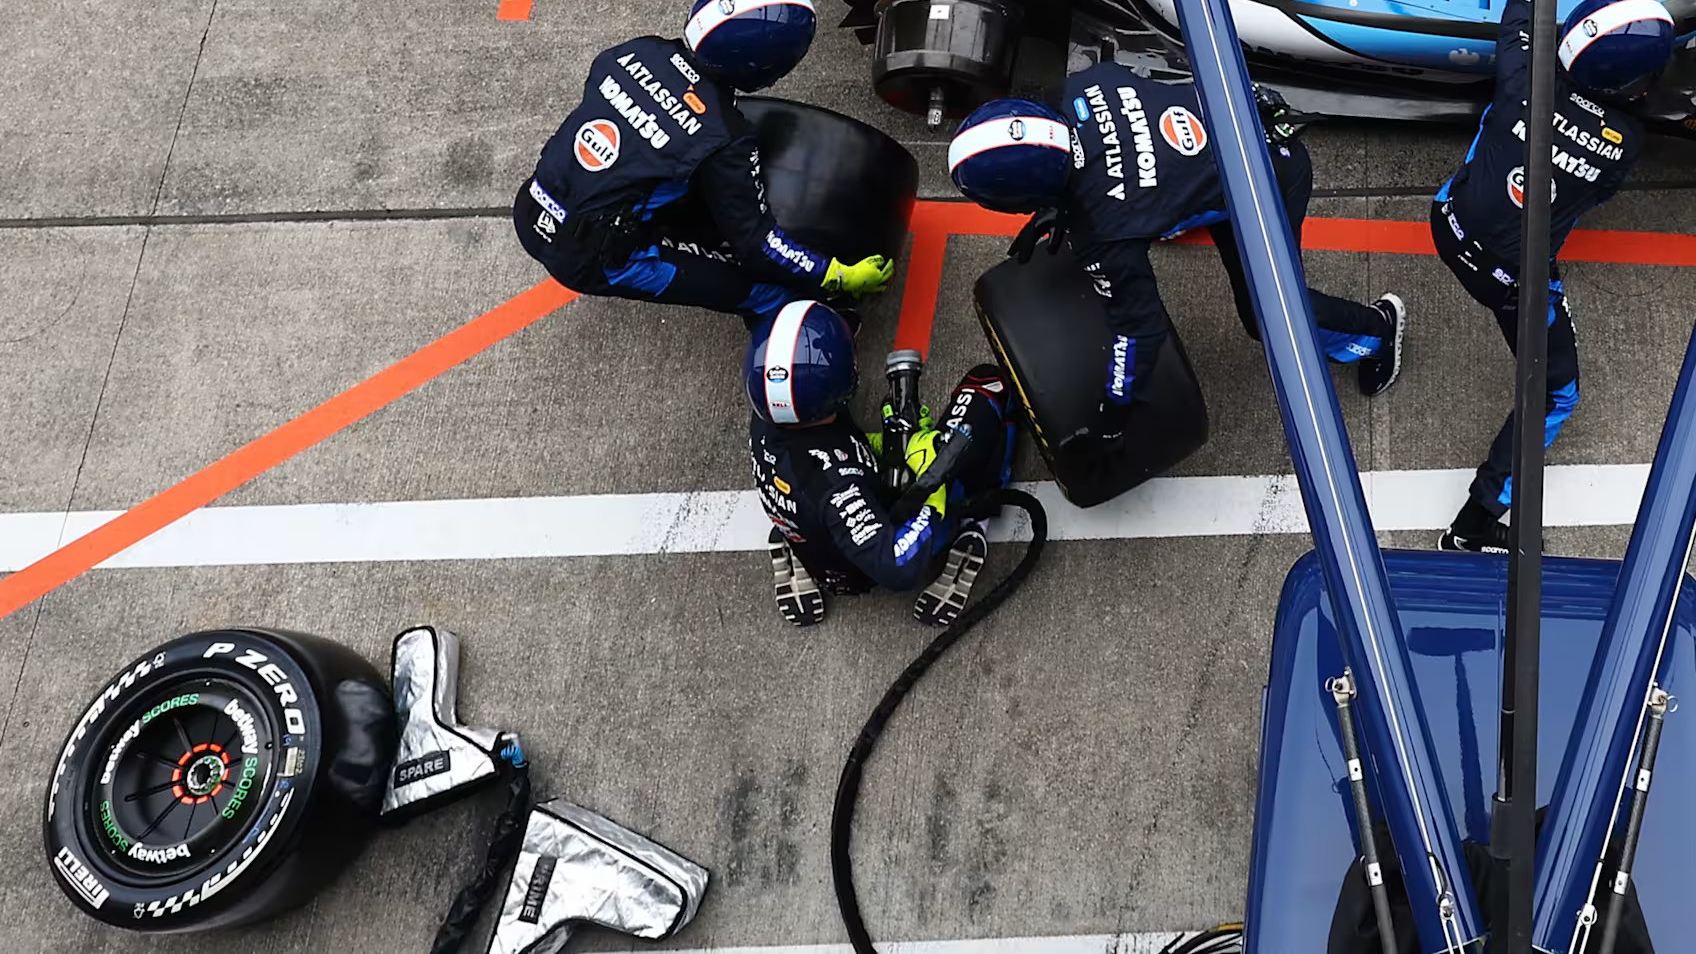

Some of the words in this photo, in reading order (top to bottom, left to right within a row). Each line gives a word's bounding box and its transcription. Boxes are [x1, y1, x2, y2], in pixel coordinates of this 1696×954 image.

[669, 53, 701, 84] sparco
[598, 74, 671, 150] KOMATSU
[625, 61, 703, 136] ATLASSIAN
[1568, 92, 1605, 118] sparco
[580, 127, 615, 164] Gulf
[1071, 126, 1086, 169] sparco
[1083, 84, 1125, 179] ATLASSIAN
[1116, 86, 1158, 188] KOMATSU
[1173, 110, 1195, 151] Gulf
[1511, 119, 1602, 183] KATSU
[1551, 111, 1624, 161] TLASSIAN
[529, 181, 568, 223] sparco
[764, 230, 815, 274] KOMATSU
[202, 642, 236, 659] P
[235, 648, 306, 735] ZERO
[100, 719, 141, 785] betway
[142, 693, 200, 725] SCORES
[222, 698, 259, 755] betway
[221, 756, 259, 821] SCORES
[398, 757, 445, 783] SPARE
[99, 800, 129, 853] SCORES
[128, 841, 192, 865] betway
[55, 846, 110, 910] PIRELLI
[524, 859, 555, 918] PRIME
